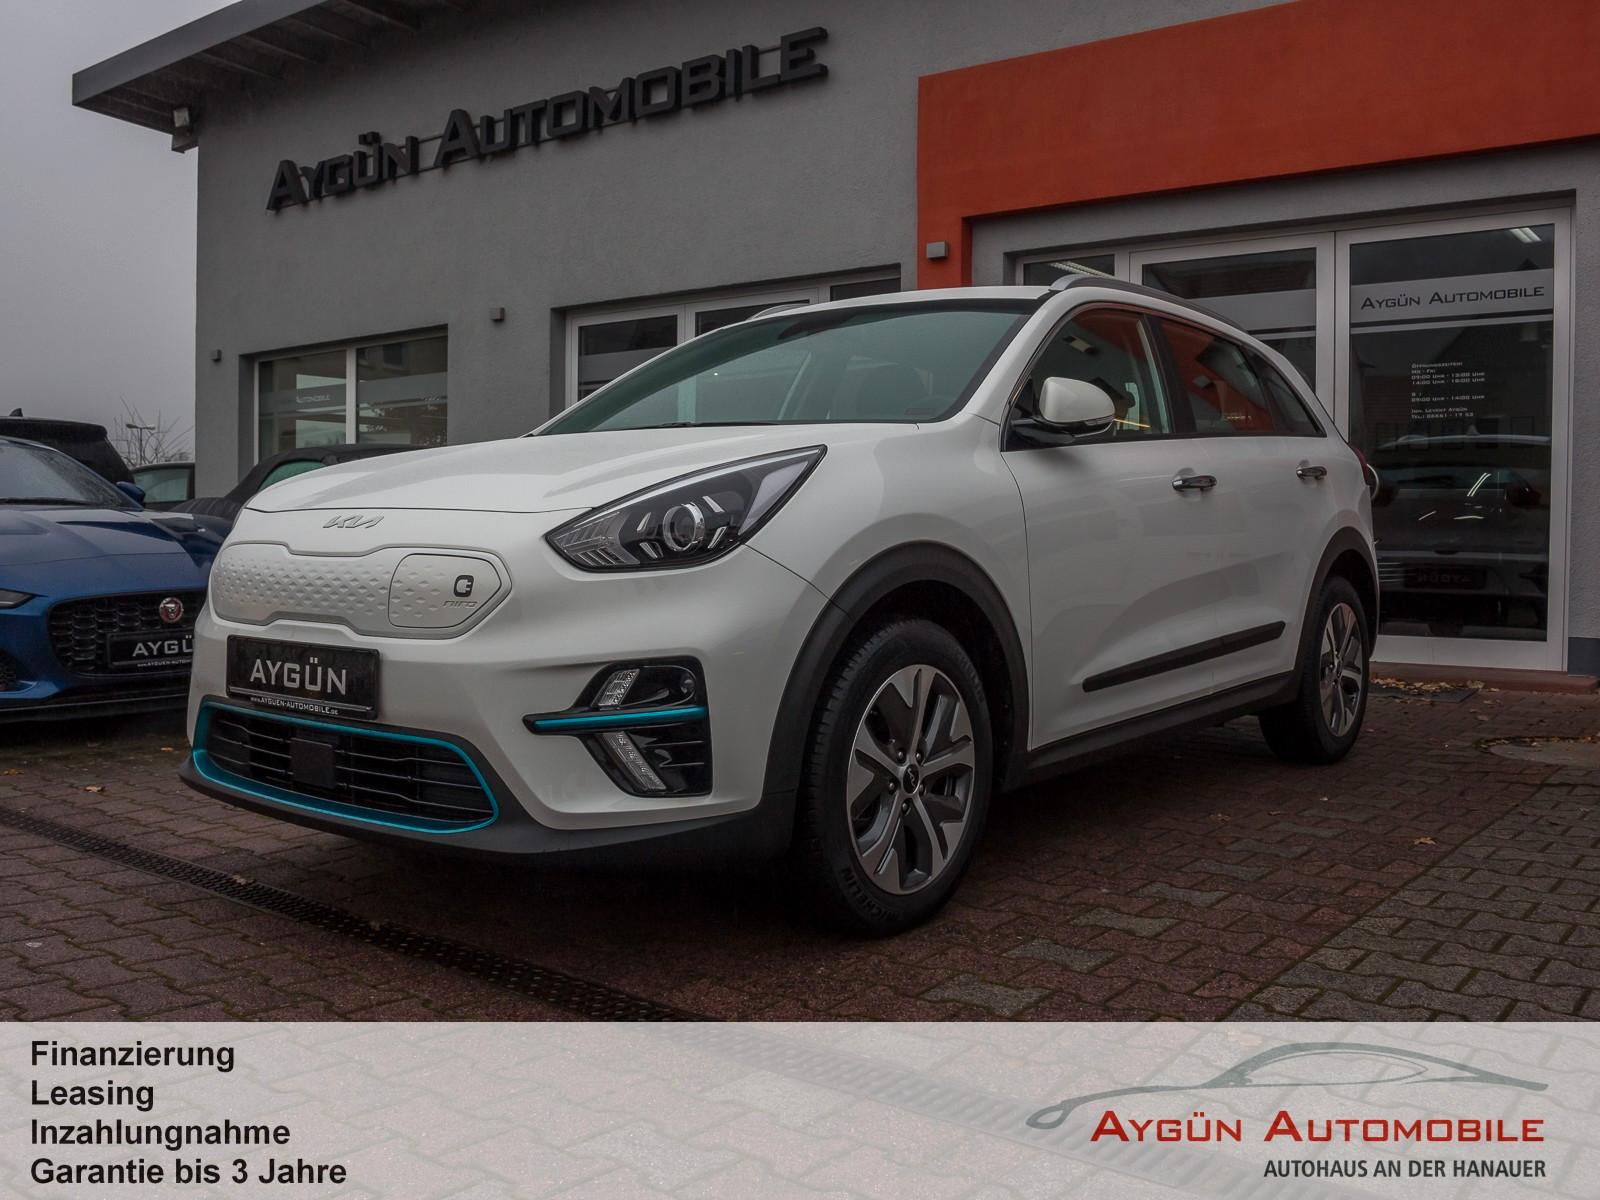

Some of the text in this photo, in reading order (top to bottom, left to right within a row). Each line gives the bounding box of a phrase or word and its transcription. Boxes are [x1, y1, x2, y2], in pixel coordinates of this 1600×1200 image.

[266, 26, 828, 211] AYGÜN AUTOMOBILE
[1360, 286, 1545, 310] AYGÜN AUTOMOBILE
[132, 634, 193, 657] AYGÜ
[250, 657, 347, 696] AYGÜN
